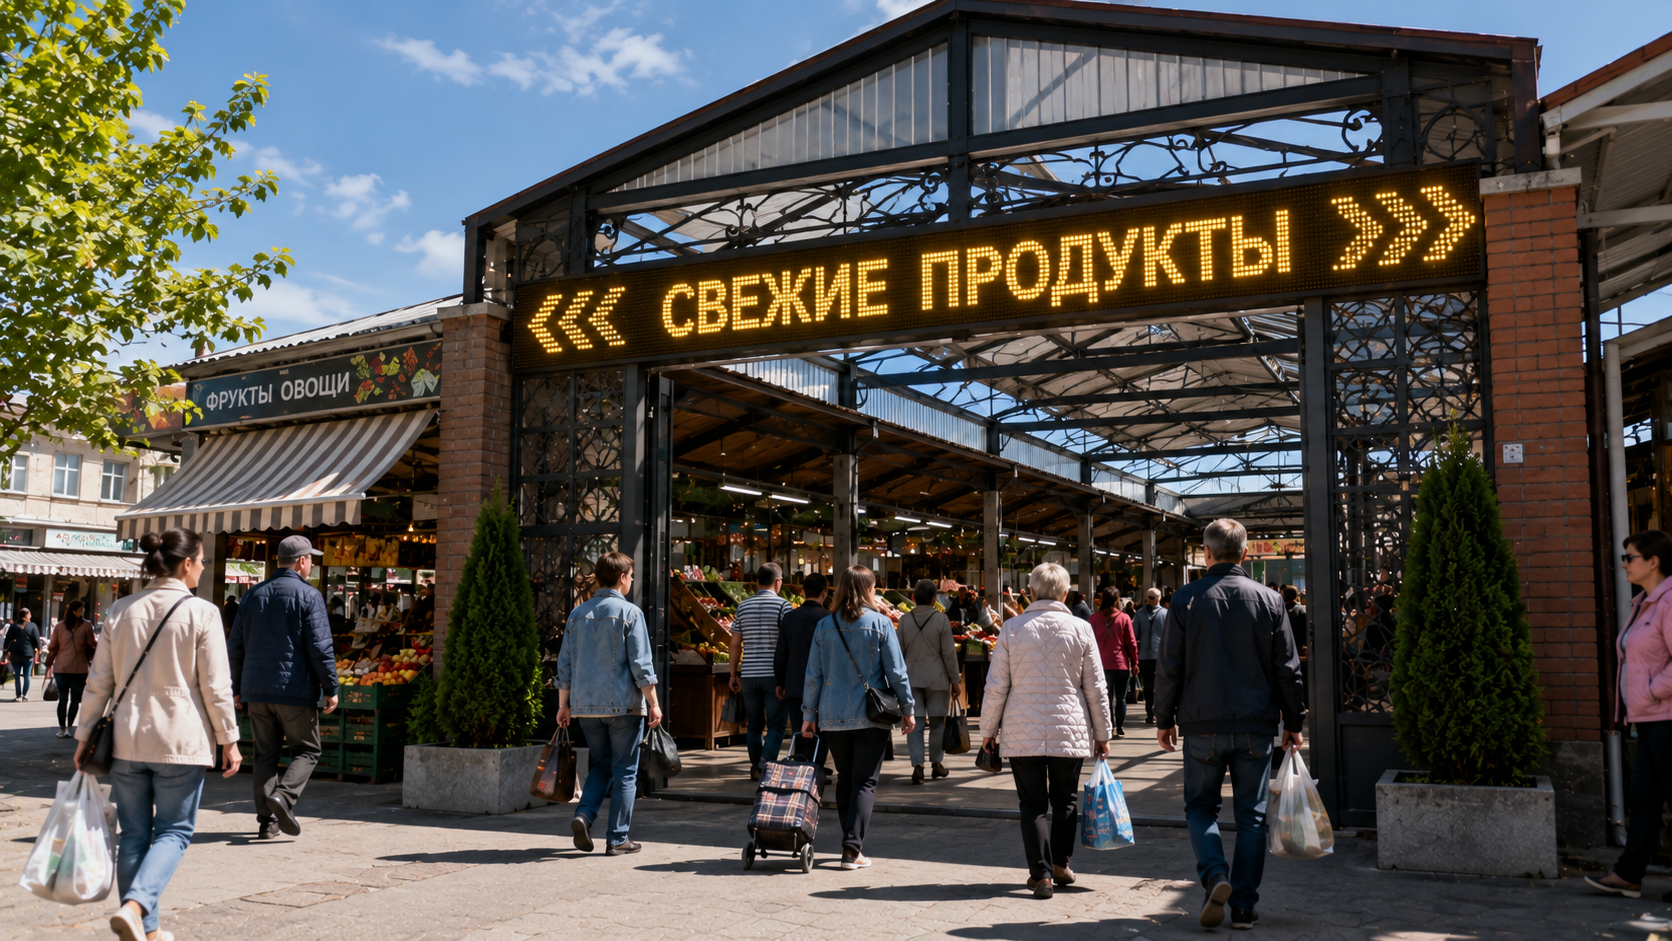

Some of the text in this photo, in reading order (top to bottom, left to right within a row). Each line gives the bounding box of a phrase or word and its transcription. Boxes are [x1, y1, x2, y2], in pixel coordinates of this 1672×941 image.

[662, 210, 1290, 338] СВЕЖИЕ ПРОДУКТЫ
[206, 371, 350, 411] ФРУКТЫ ОВОЩИ
